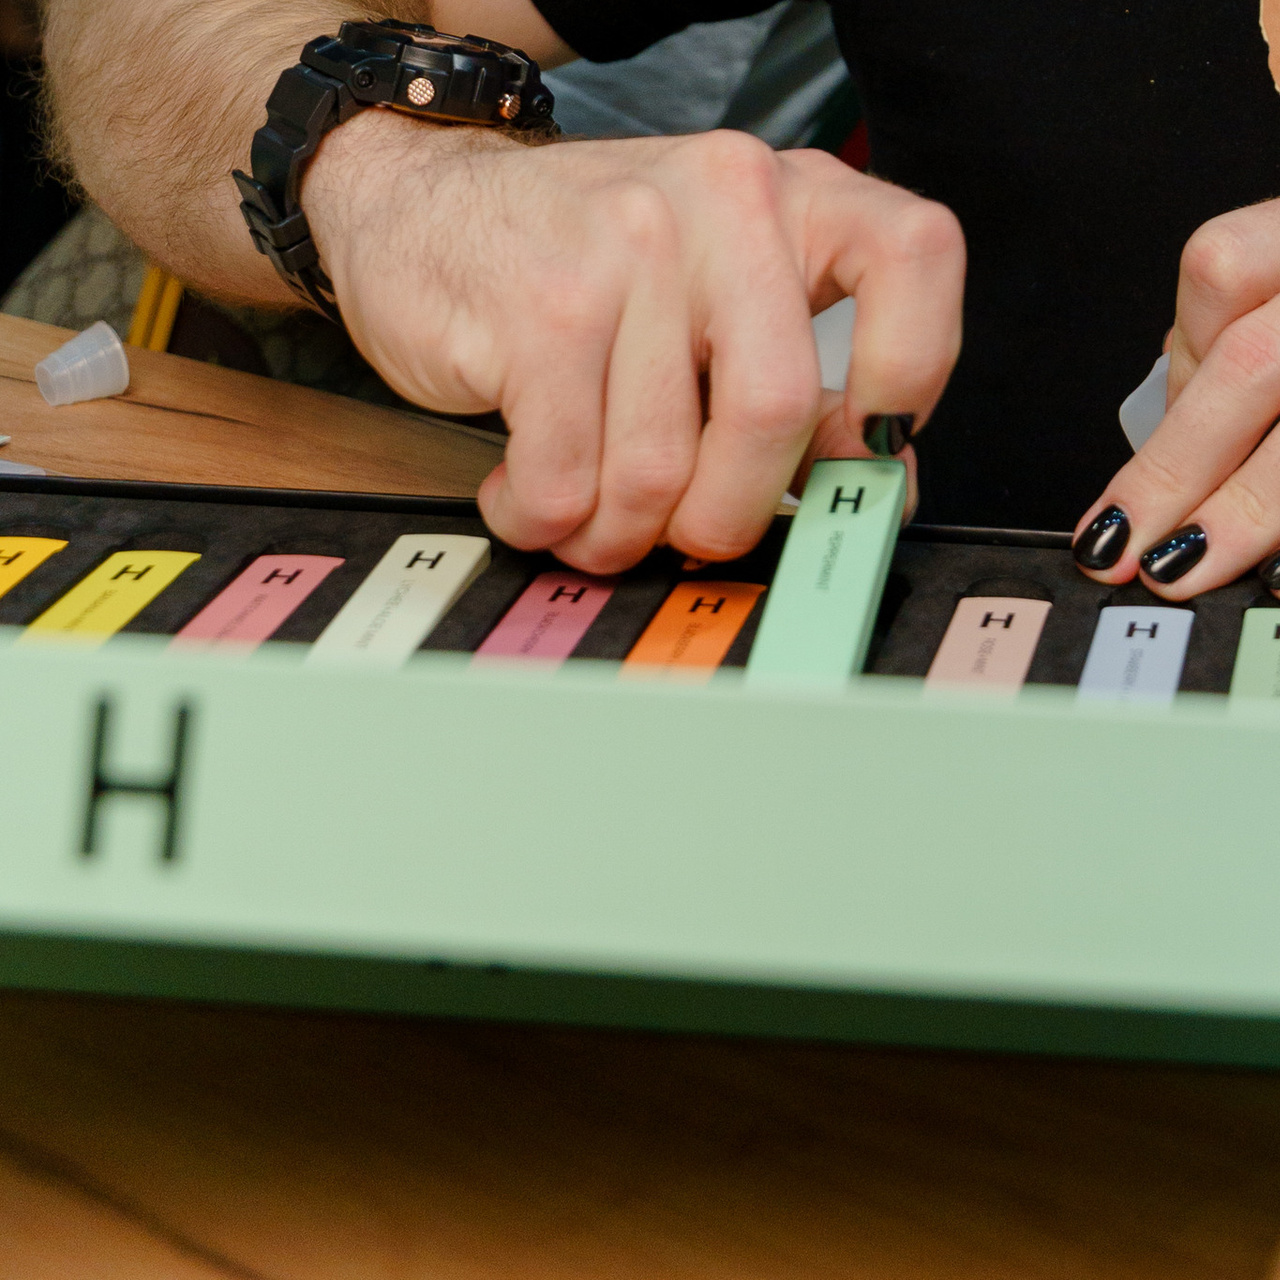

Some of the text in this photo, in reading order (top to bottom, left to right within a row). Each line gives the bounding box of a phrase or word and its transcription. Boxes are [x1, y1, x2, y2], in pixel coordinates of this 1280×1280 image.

[829, 486, 865, 514] H
[405, 550, 447, 569] H
[110, 564, 154, 580] H
[261, 568, 304, 585] H
[548, 585, 589, 603] H
[688, 596, 727, 614] H
[980, 611, 1015, 628] H
[1125, 621, 1159, 639] H
[78, 698, 192, 862] H
